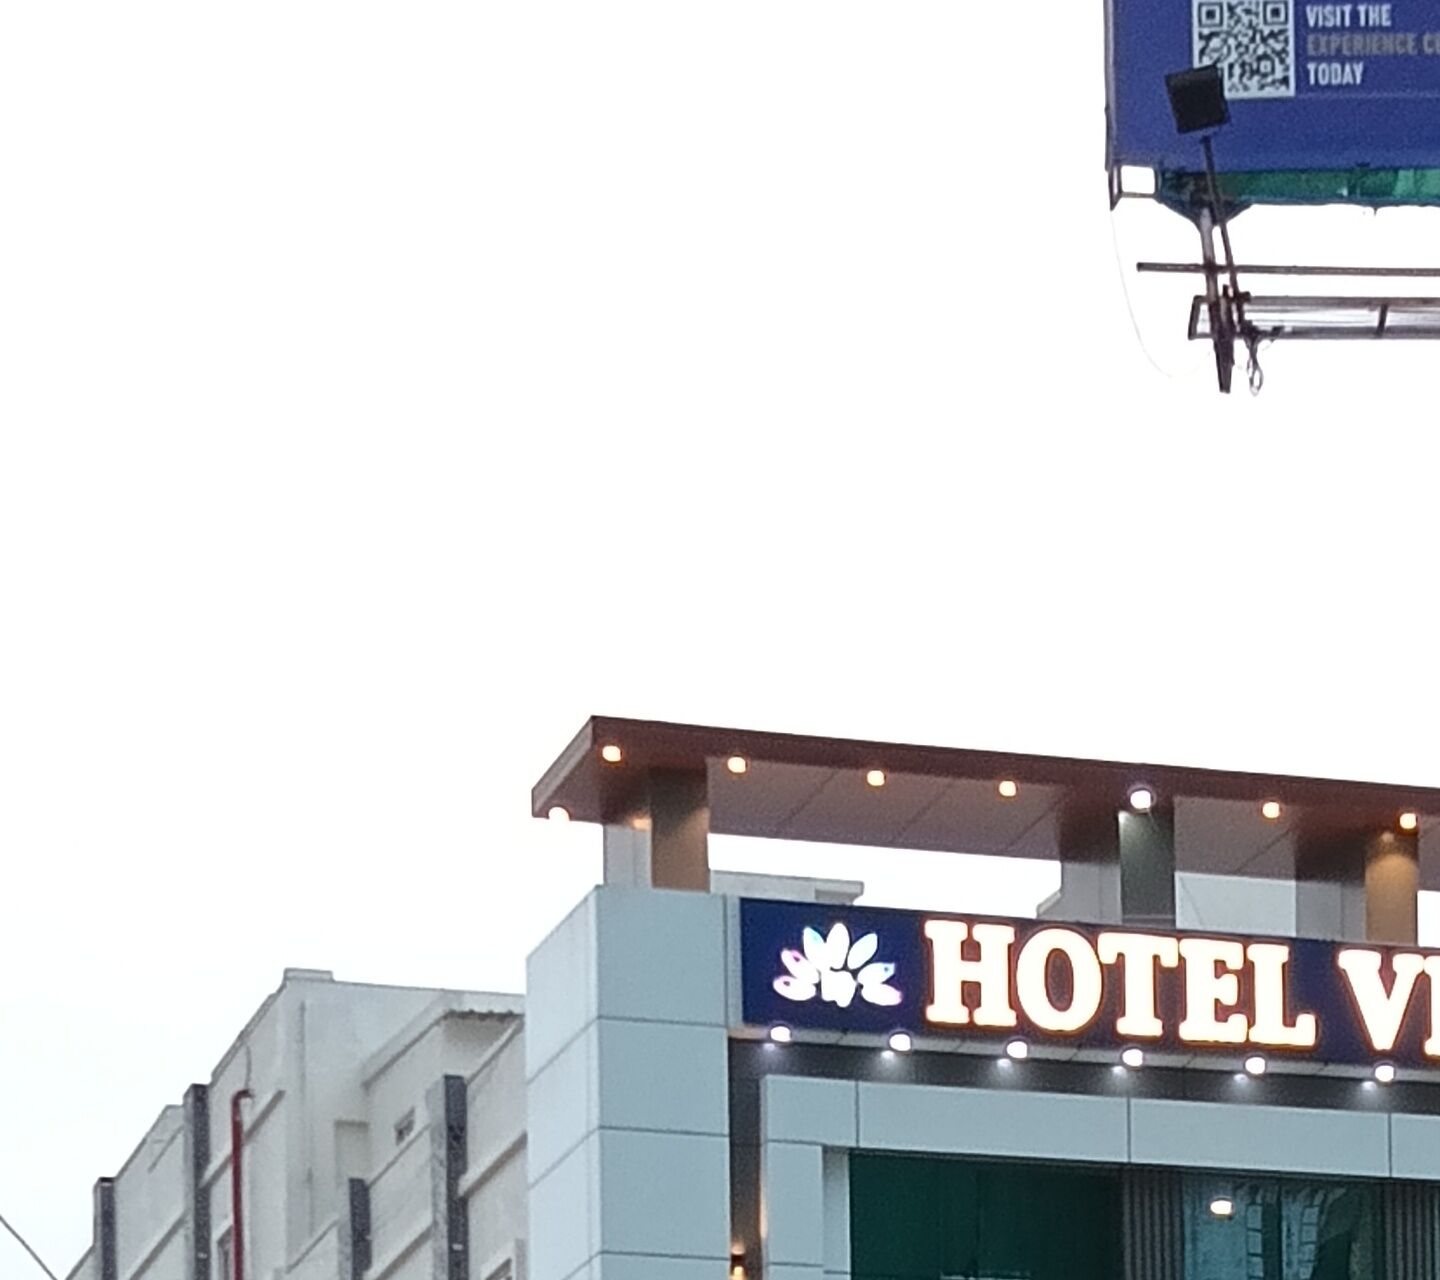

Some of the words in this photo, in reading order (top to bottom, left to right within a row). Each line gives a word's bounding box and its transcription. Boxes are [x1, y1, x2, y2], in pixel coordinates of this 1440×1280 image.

[1306, 4, 1352, 28] VISIT
[1357, 4, 1392, 28] THE
[1307, 32, 1418, 57] EXPERIENCE
[1307, 61, 1364, 86] TODAY
[923, 919, 1317, 1047] HOTEL
